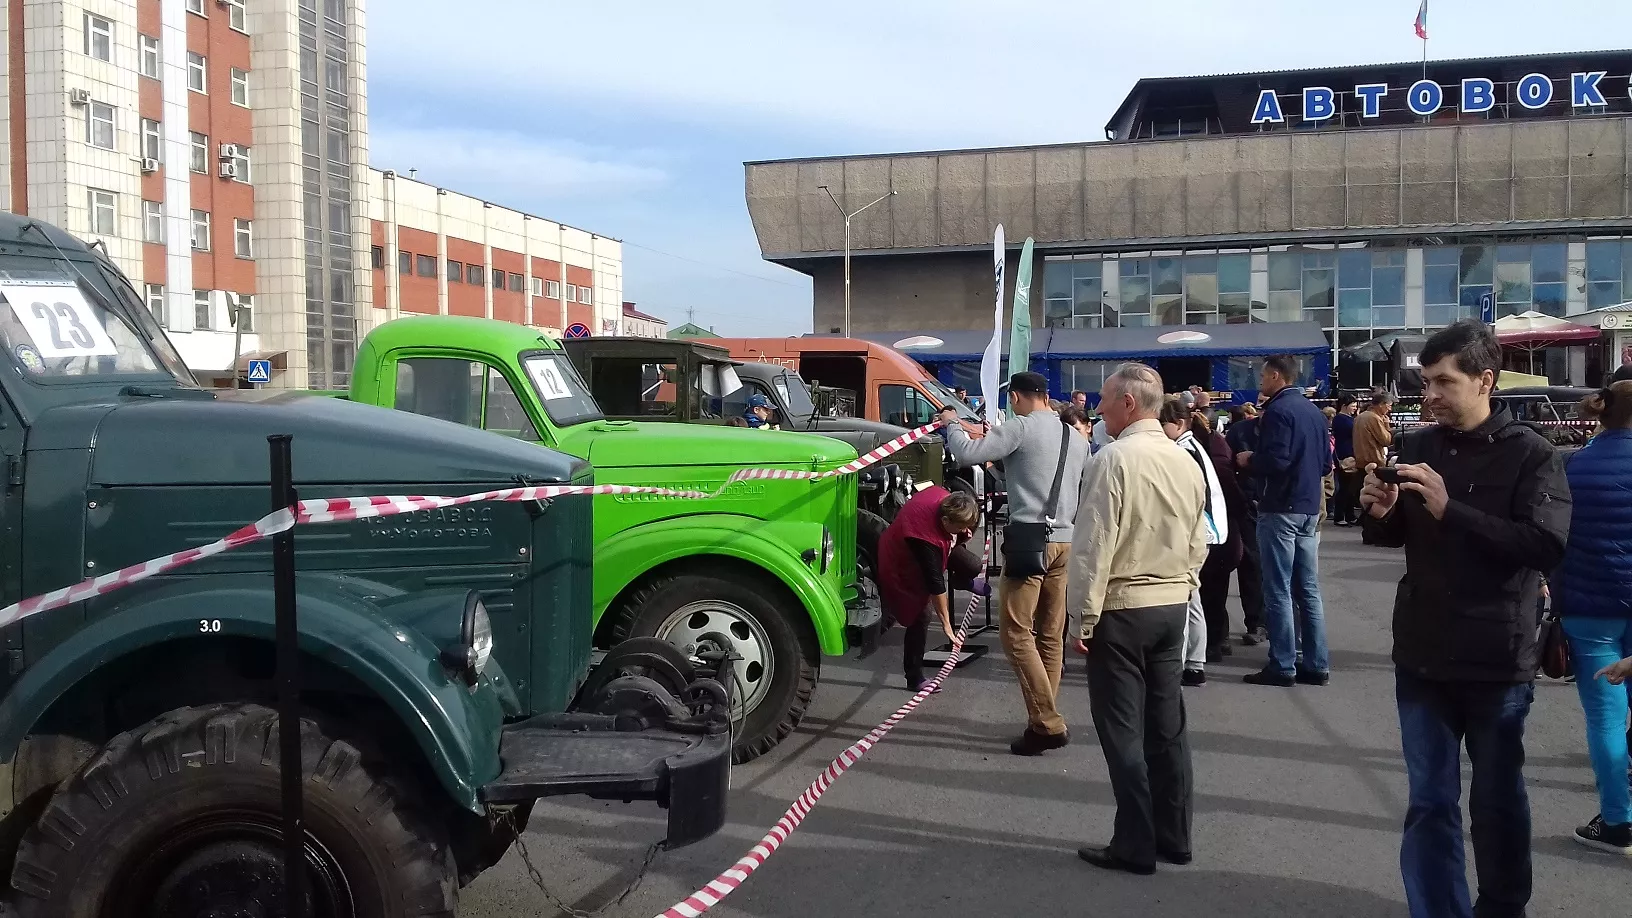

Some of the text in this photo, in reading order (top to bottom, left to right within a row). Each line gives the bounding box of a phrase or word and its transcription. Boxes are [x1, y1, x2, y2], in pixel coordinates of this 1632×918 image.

[1251, 71, 1632, 124] АВТОВОК
[31, 301, 95, 350] 23
[540, 368, 564, 395] 12
[360, 506, 493, 524] ОЗАВОД
[200, 619, 221, 633] 3.0
